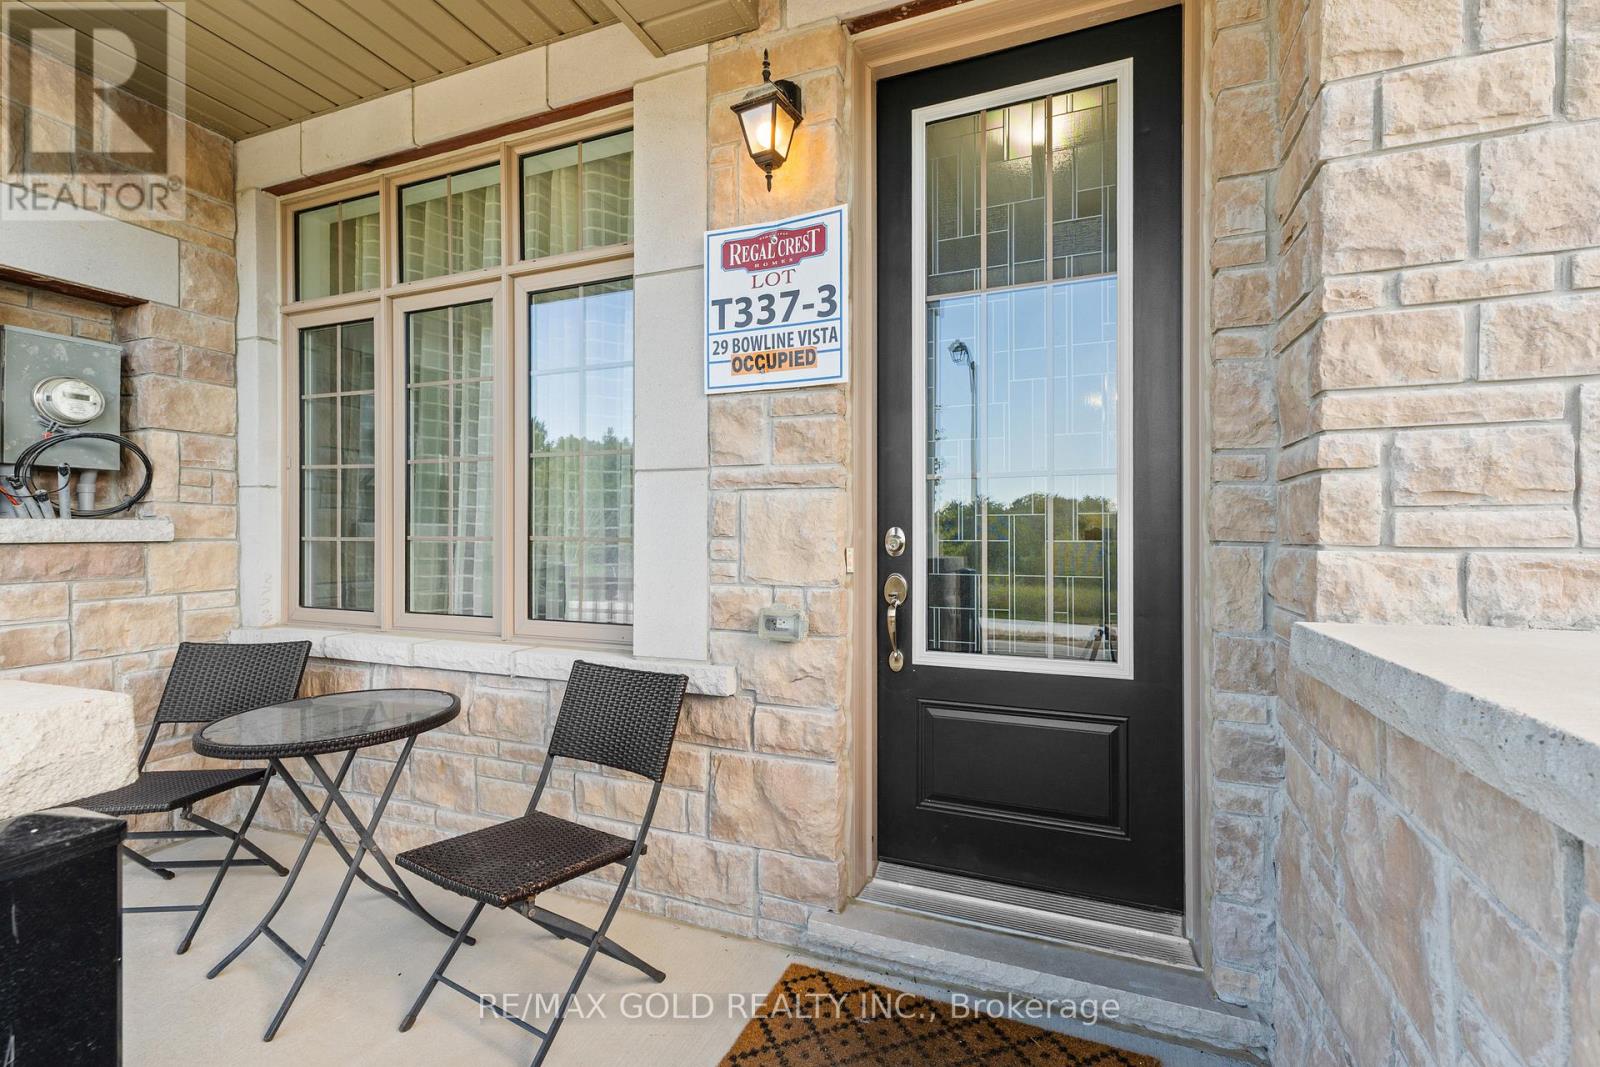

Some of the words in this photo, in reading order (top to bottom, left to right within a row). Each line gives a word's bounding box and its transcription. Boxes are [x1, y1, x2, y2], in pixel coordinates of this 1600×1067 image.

[729, 242, 776, 266] REGAL
[777, 228, 821, 257] CREST
[751, 268, 796, 289] LOT
[711, 284, 838, 331] T337-3
[712, 339, 729, 356] 29
[732, 331, 795, 354] BOWLINE
[797, 326, 839, 347] VISTA
[731, 348, 817, 374] OCCUPIED
